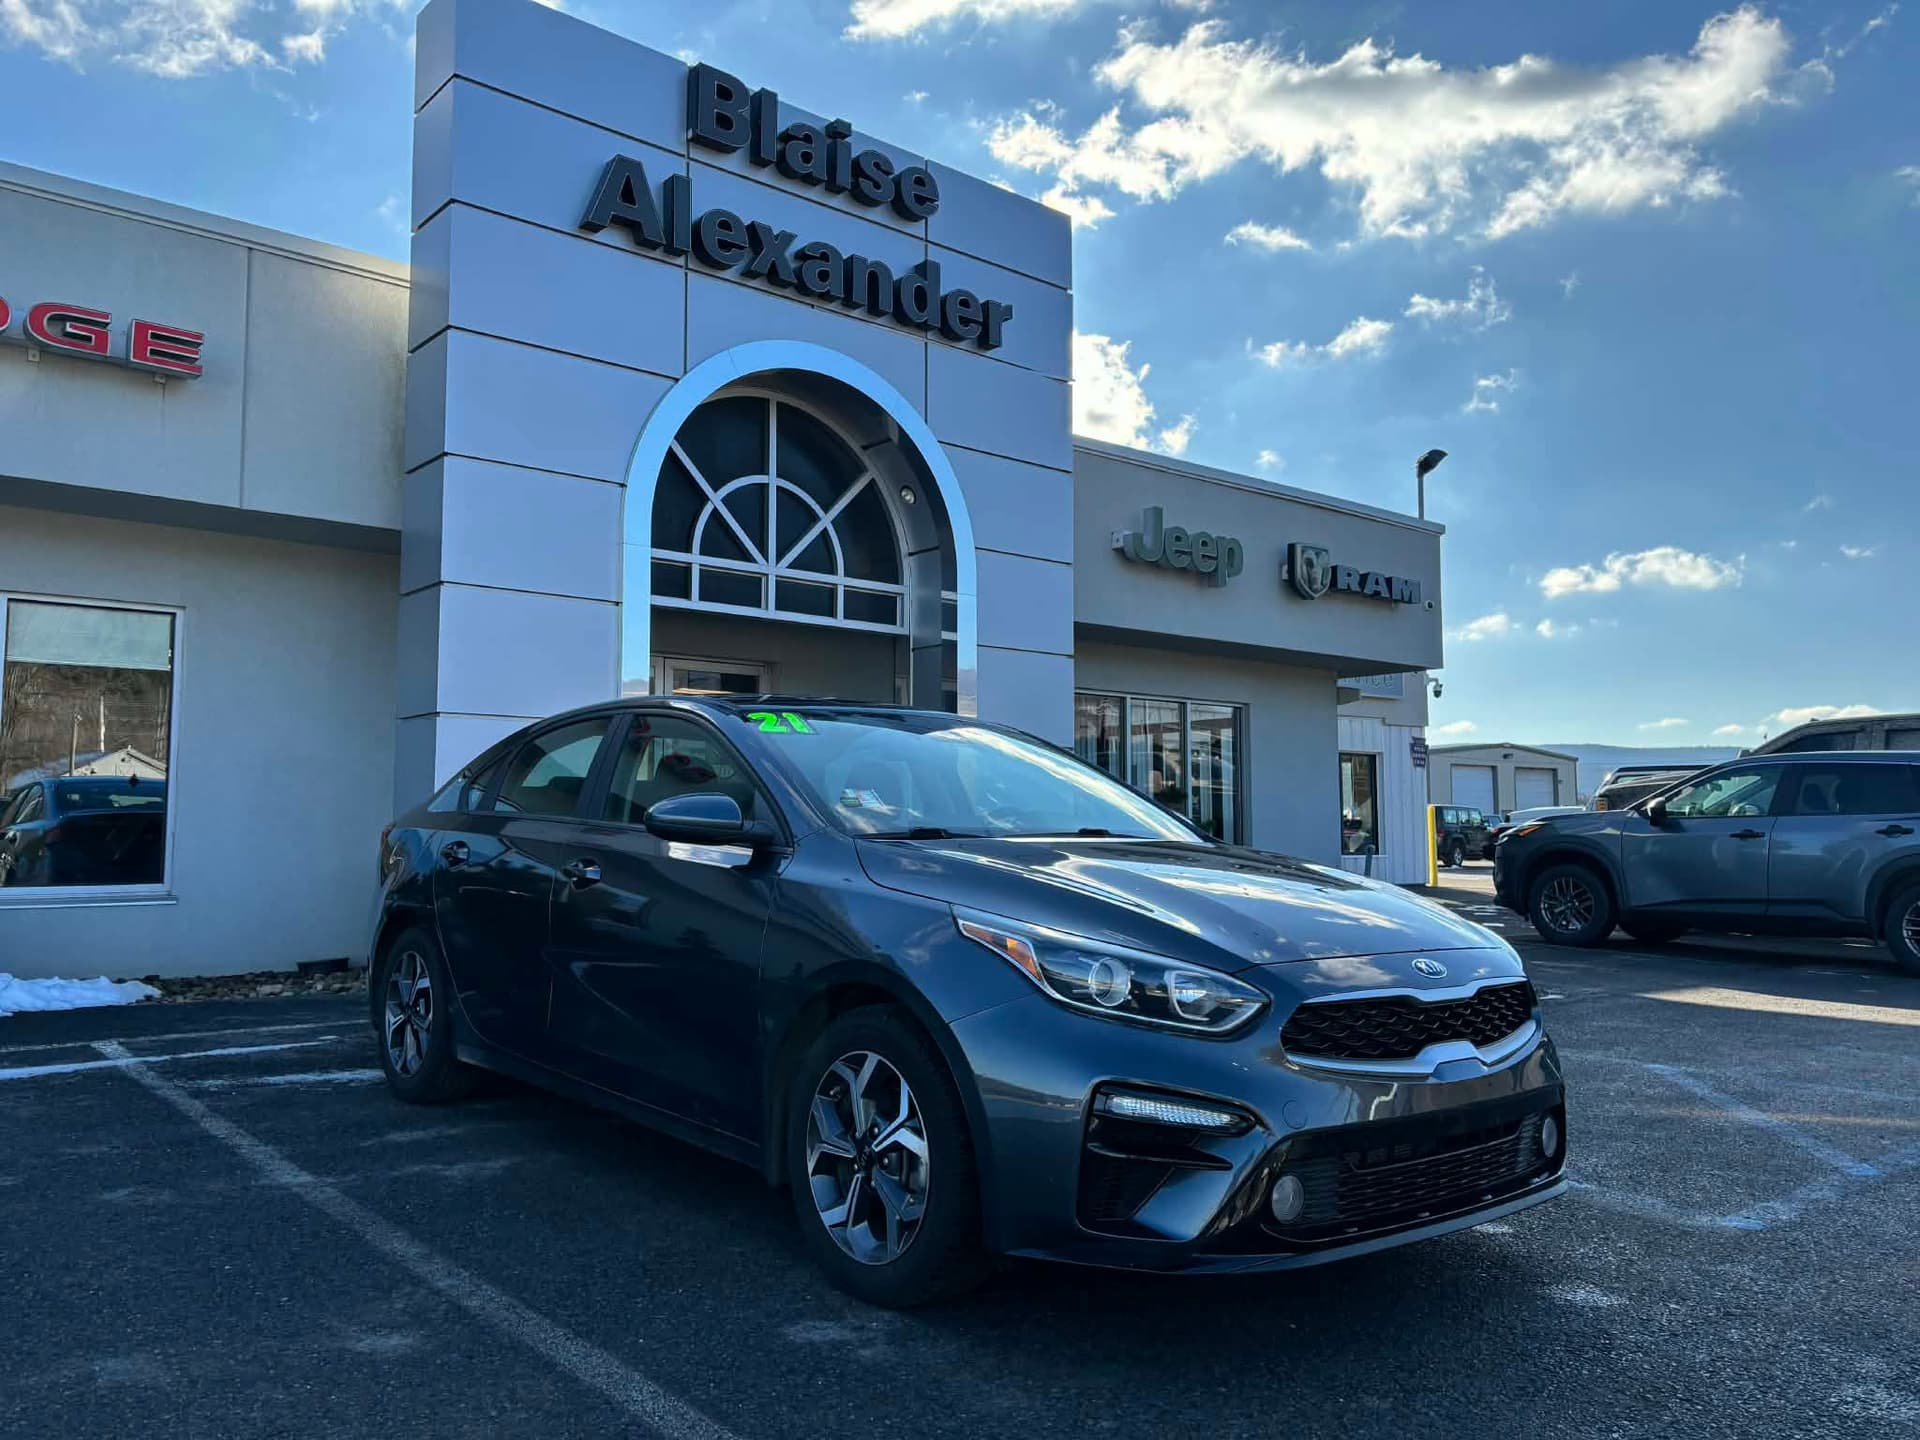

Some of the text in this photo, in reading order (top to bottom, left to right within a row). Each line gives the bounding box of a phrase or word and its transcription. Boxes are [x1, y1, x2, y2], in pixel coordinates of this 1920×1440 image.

[684, 62, 939, 222] Blaise
[579, 154, 1013, 350] Alexander
[0, 297, 204, 379] GE
[1122, 506, 1245, 587] Jeep
[1331, 564, 1421, 604] RAM
[747, 712, 816, 734] 21
